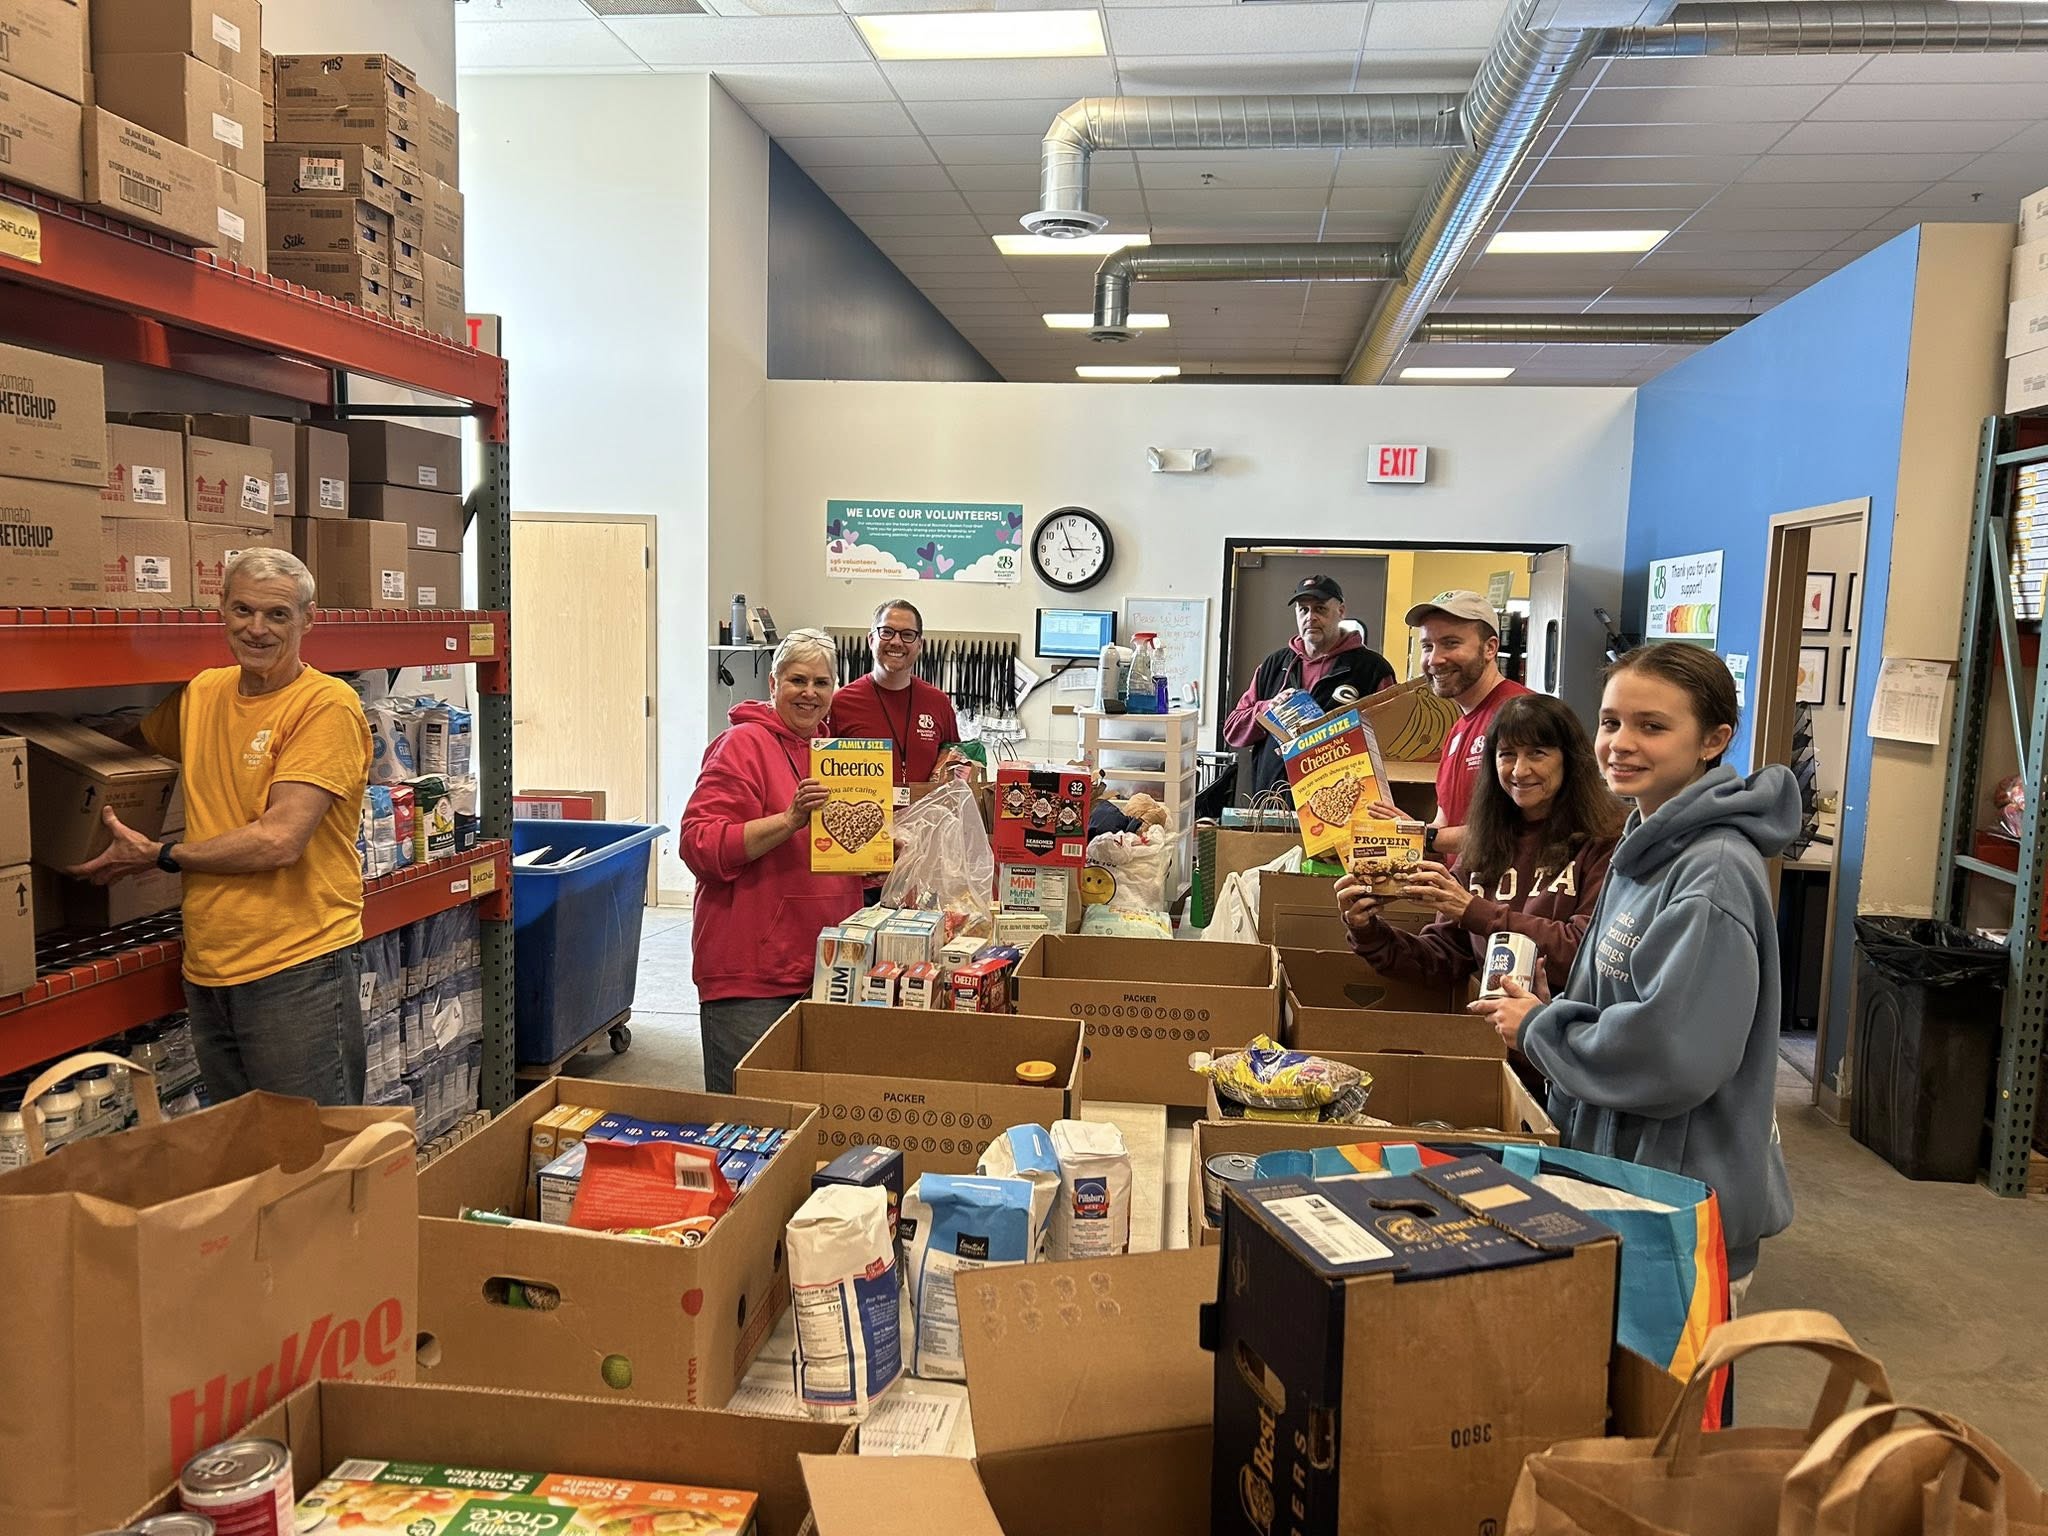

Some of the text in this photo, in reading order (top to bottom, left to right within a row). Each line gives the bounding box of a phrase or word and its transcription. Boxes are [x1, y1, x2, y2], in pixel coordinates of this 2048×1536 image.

[125, 127, 156, 147] BLACK BEAN
[130, 138, 148, 154] POUND
[148, 145, 162, 160] BAGS
[108, 160, 125, 174] STORE
[125, 166, 131, 176] IN
[131, 169, 145, 182] COOL
[145, 174, 156, 186] DRY
[156, 177, 172, 192] PLACE
[282, 233, 305, 249] Silk
[1379, 447, 1418, 477] EXIT
[846, 507, 1002, 521] WE LOVE OUR VOLUNTEERS!
[1069, 519, 1077, 527] 12
[1046, 531, 1054, 540] 10
[1041, 545, 1046, 553] 9
[1095, 546, 1101, 554] 3
[1045, 558, 1050, 566] 8
[1054, 567, 1059, 575] 7
[1067, 572, 1072, 580] 6
[1081, 568, 1086, 576] 5
[1671, 561, 1717, 579] Thank you for your
[1680, 580, 1702, 599] support!
[1297, 718, 1350, 750] GIANT SIZE
[838, 740, 885, 749] FAMILY SIZE
[1300, 743, 1351, 774] Cheerios
[820, 758, 885, 777] Cheerios
[14, 782, 24, 790] UP
[829, 786, 841, 795] You
[854, 786, 877, 796] caring
[1070, 782, 1083, 791] 32
[1354, 836, 1411, 846] PROTEIN
[17, 908, 28, 917] UP
[954, 974, 978, 987] CHEEZ-IT
[361, 982, 370, 998] 12
[1123, 994, 1156, 1003] PACKER
[883, 1092, 926, 1104] PACKER
[1078, 1193, 1105, 1204] Pillsbury
[959, 1239, 985, 1251] Essential
[827, 1304, 841, 1312] 110
[688, 1357, 697, 1385] USA
[1254, 1405, 1277, 1484] Best
[382, 1473, 424, 1486] 10 PACK
[444, 1467, 515, 1483] with Rice
[447, 1476, 530, 1492] 5 Chicken
[562, 1477, 617, 1492] Noodle
[549, 1484, 633, 1500] 5 Chicken
[470, 1507, 560, 1530] Choice
